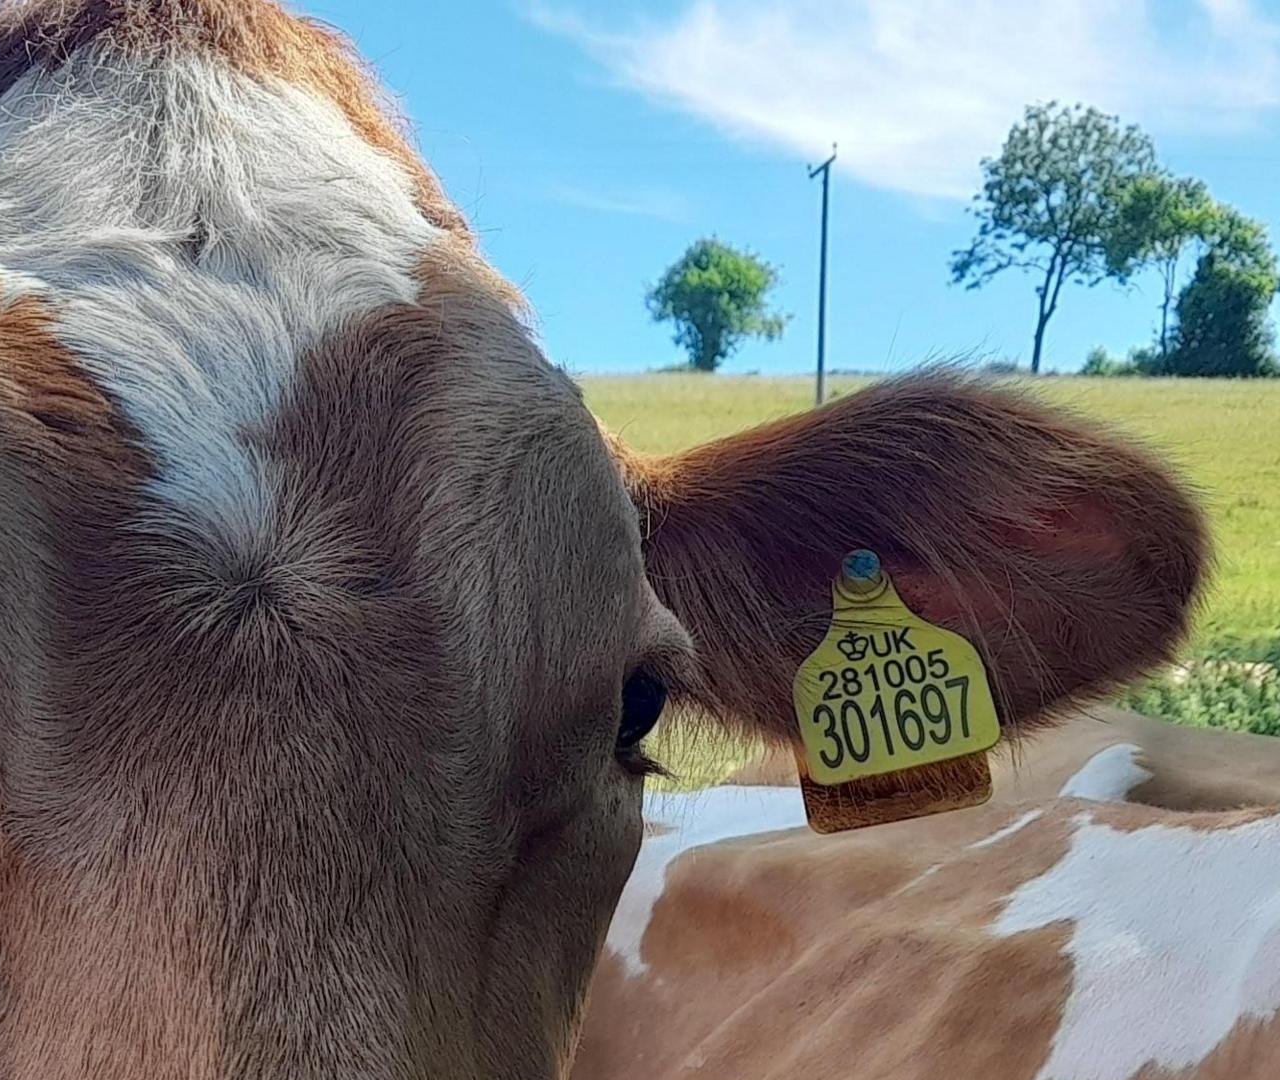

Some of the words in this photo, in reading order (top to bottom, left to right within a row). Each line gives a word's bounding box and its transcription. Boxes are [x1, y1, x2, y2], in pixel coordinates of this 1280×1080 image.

[869, 627, 916, 657] UK
[819, 648, 949, 701] 281005
[813, 675, 969, 769] 301697
